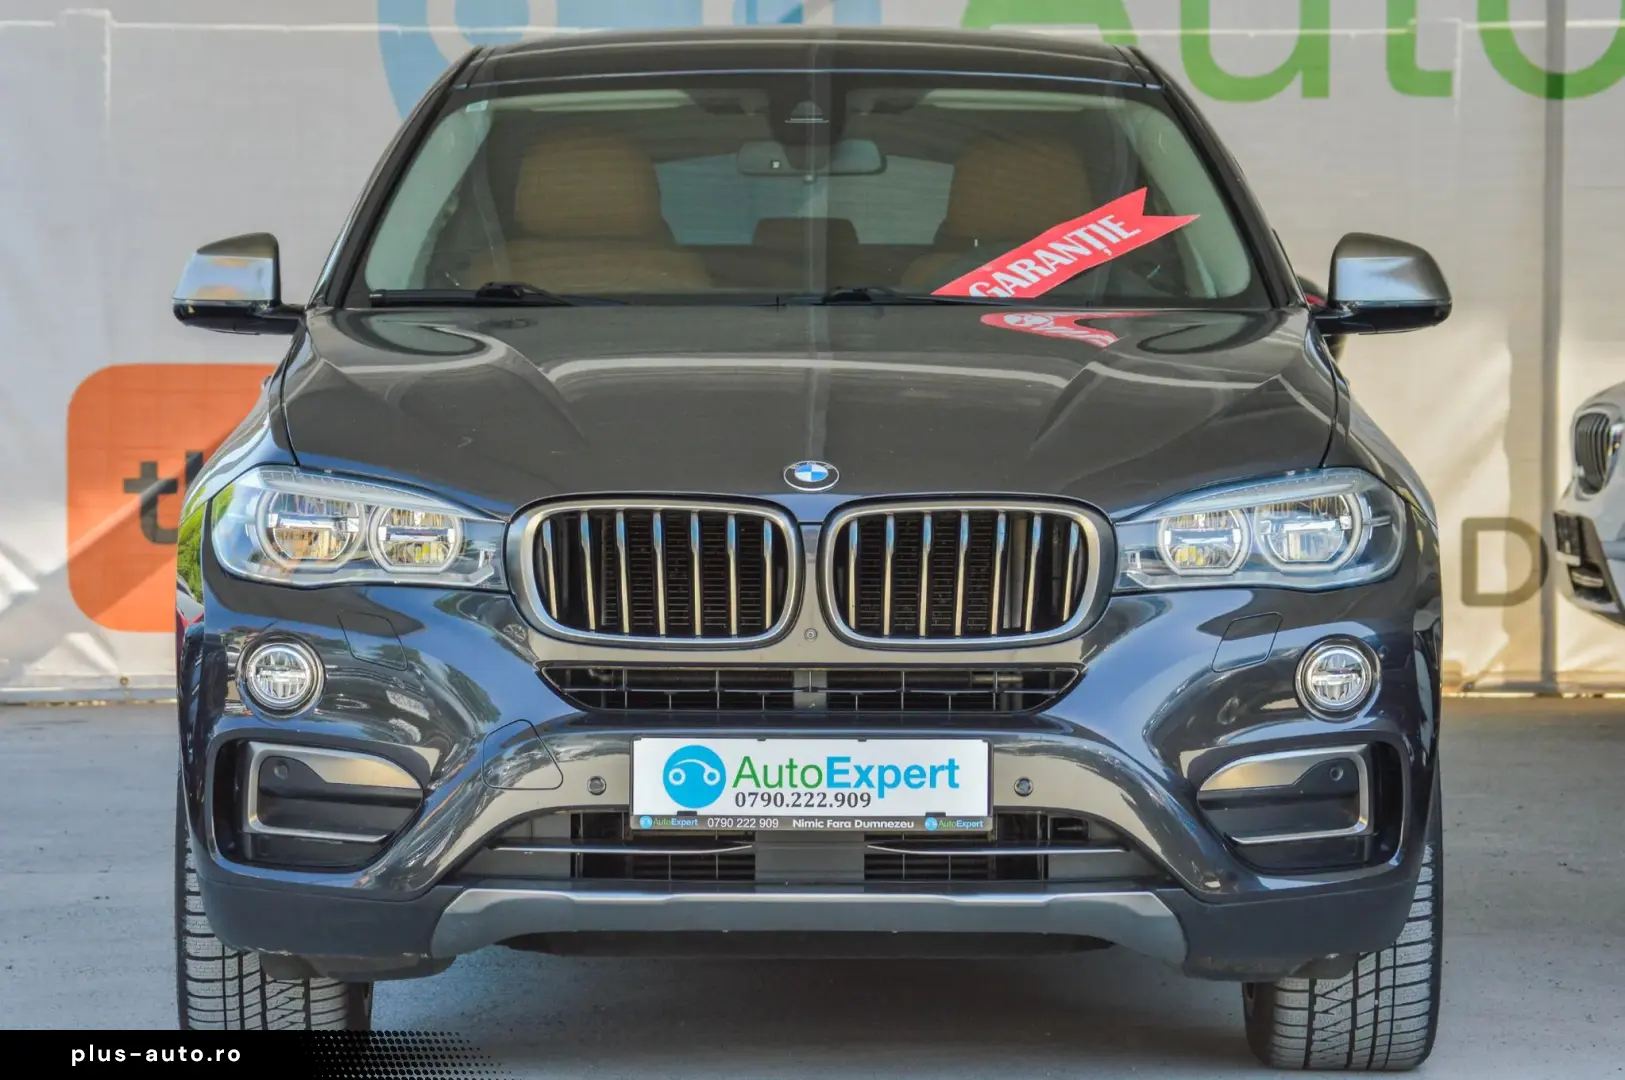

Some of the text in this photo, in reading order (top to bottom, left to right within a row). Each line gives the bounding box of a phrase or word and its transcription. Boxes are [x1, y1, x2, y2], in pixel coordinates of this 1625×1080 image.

[732, 756, 960, 799] AutoExpert
[734, 791, 872, 809] 0790.222.909
[653, 817, 984, 829] AutoExpert 0790 222 909 Nimic Fara Dumnezeu AutoExpert
